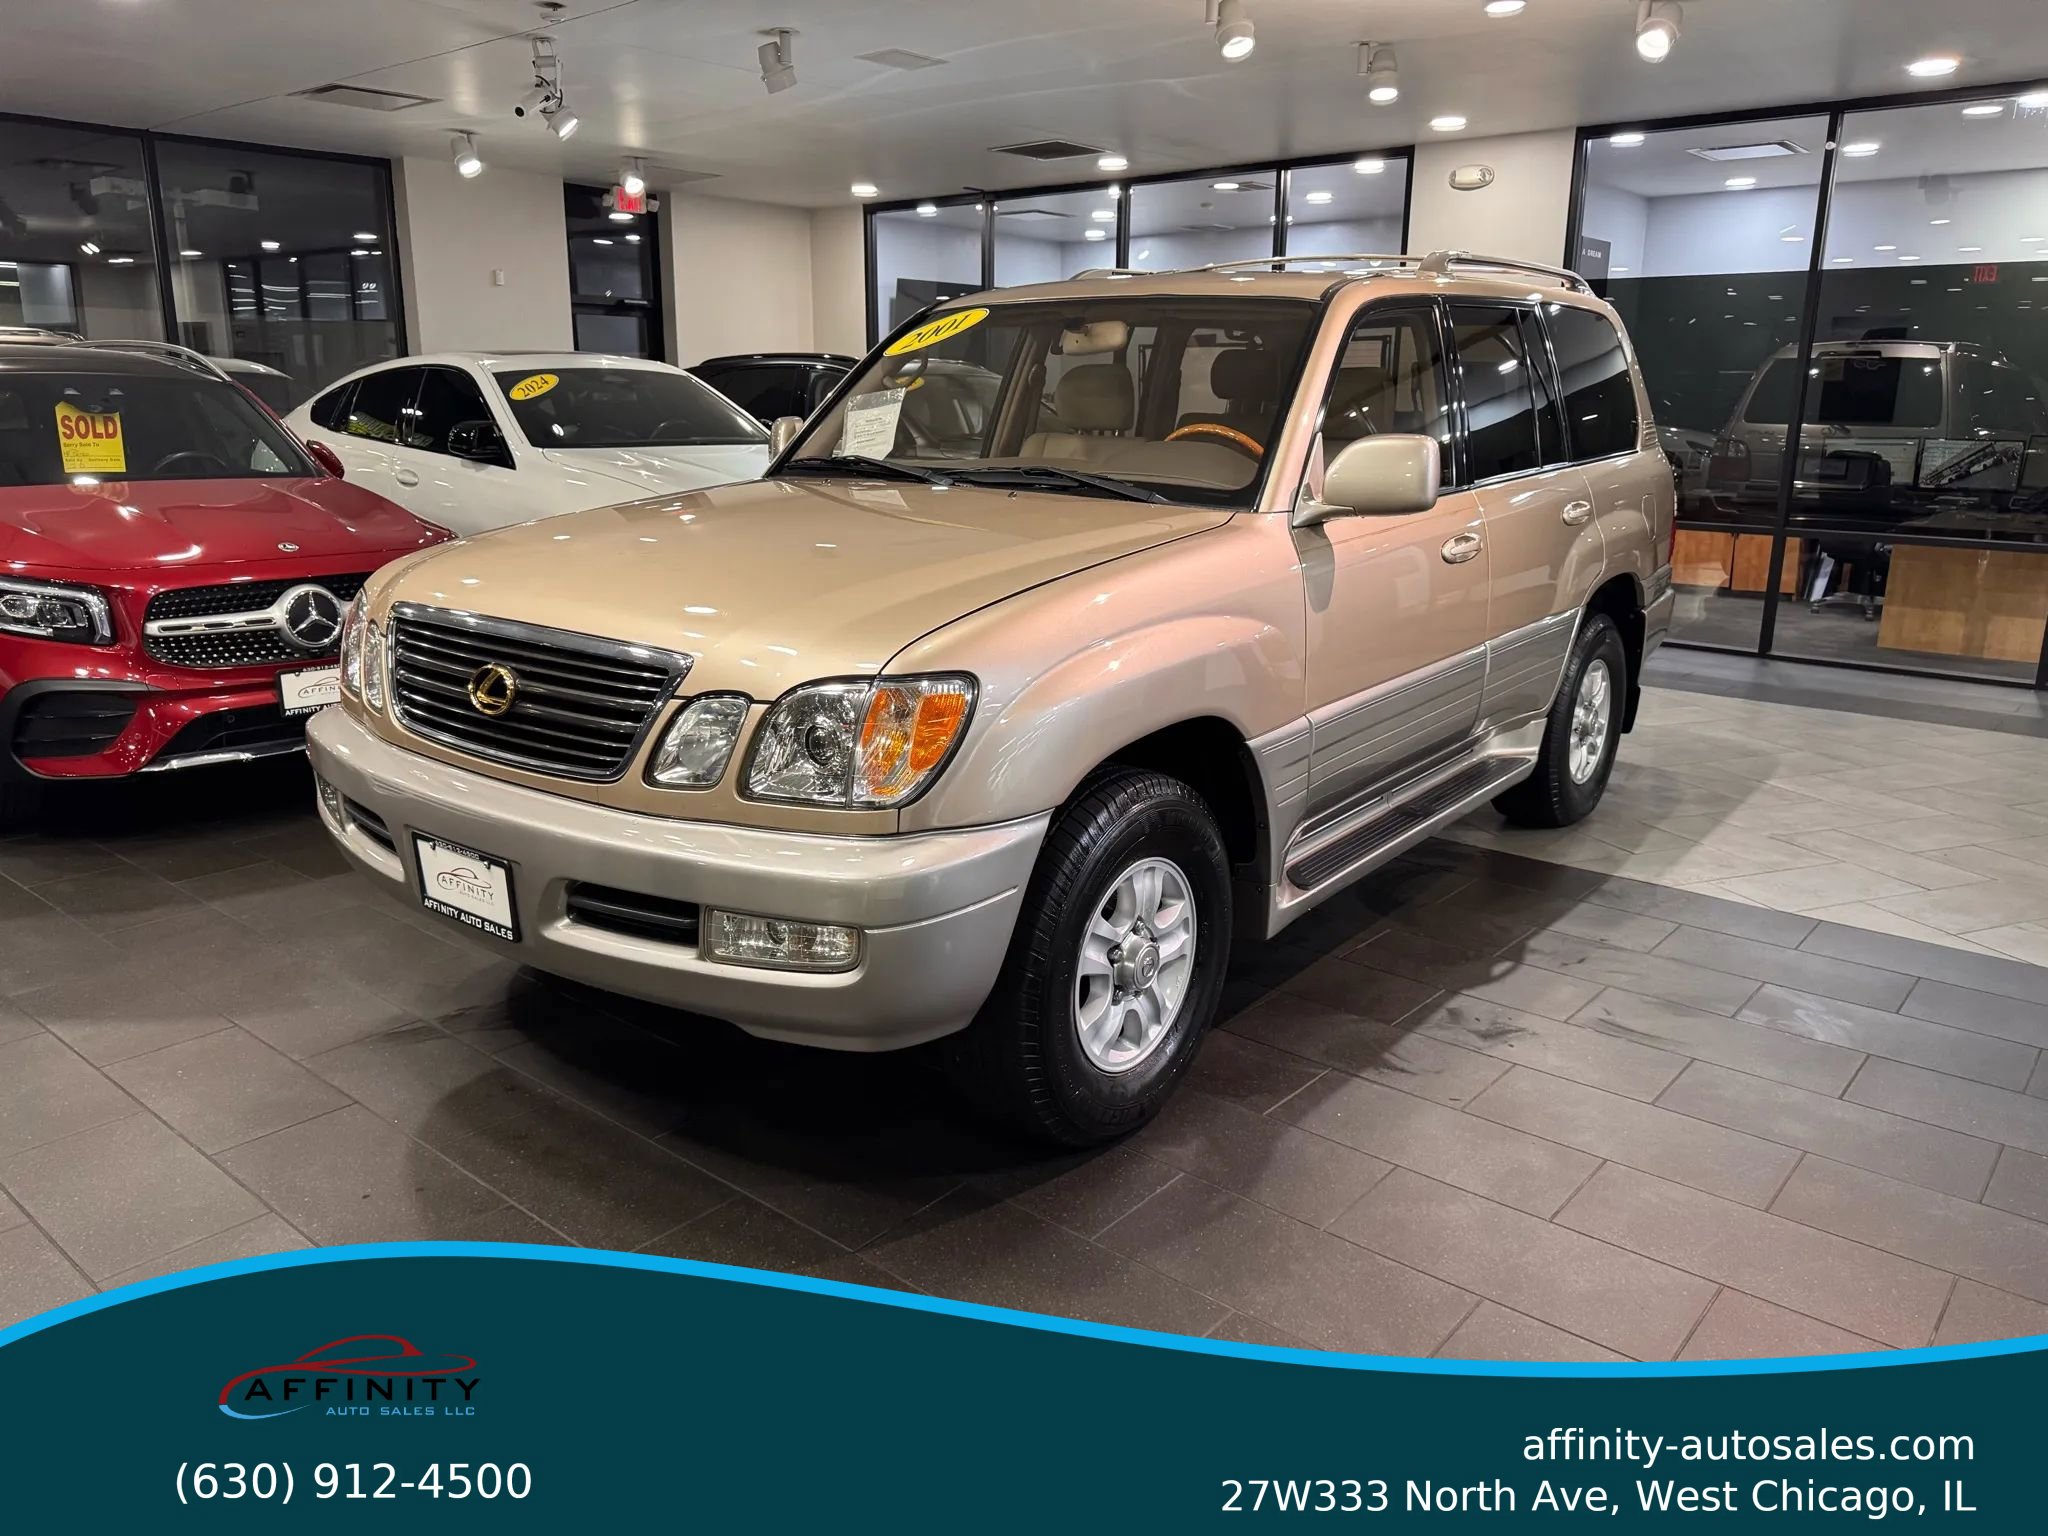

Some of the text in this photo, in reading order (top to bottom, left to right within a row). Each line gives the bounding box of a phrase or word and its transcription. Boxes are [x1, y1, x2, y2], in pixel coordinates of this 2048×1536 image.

[899, 313, 973, 352] 2001
[517, 376, 549, 397] 2024
[60, 415, 118, 440] SOLD
[285, 705, 321, 716] AFFINITY
[441, 875, 495, 901] AFFINITY
[423, 898, 514, 941] AFFINITY AUTO SALES
